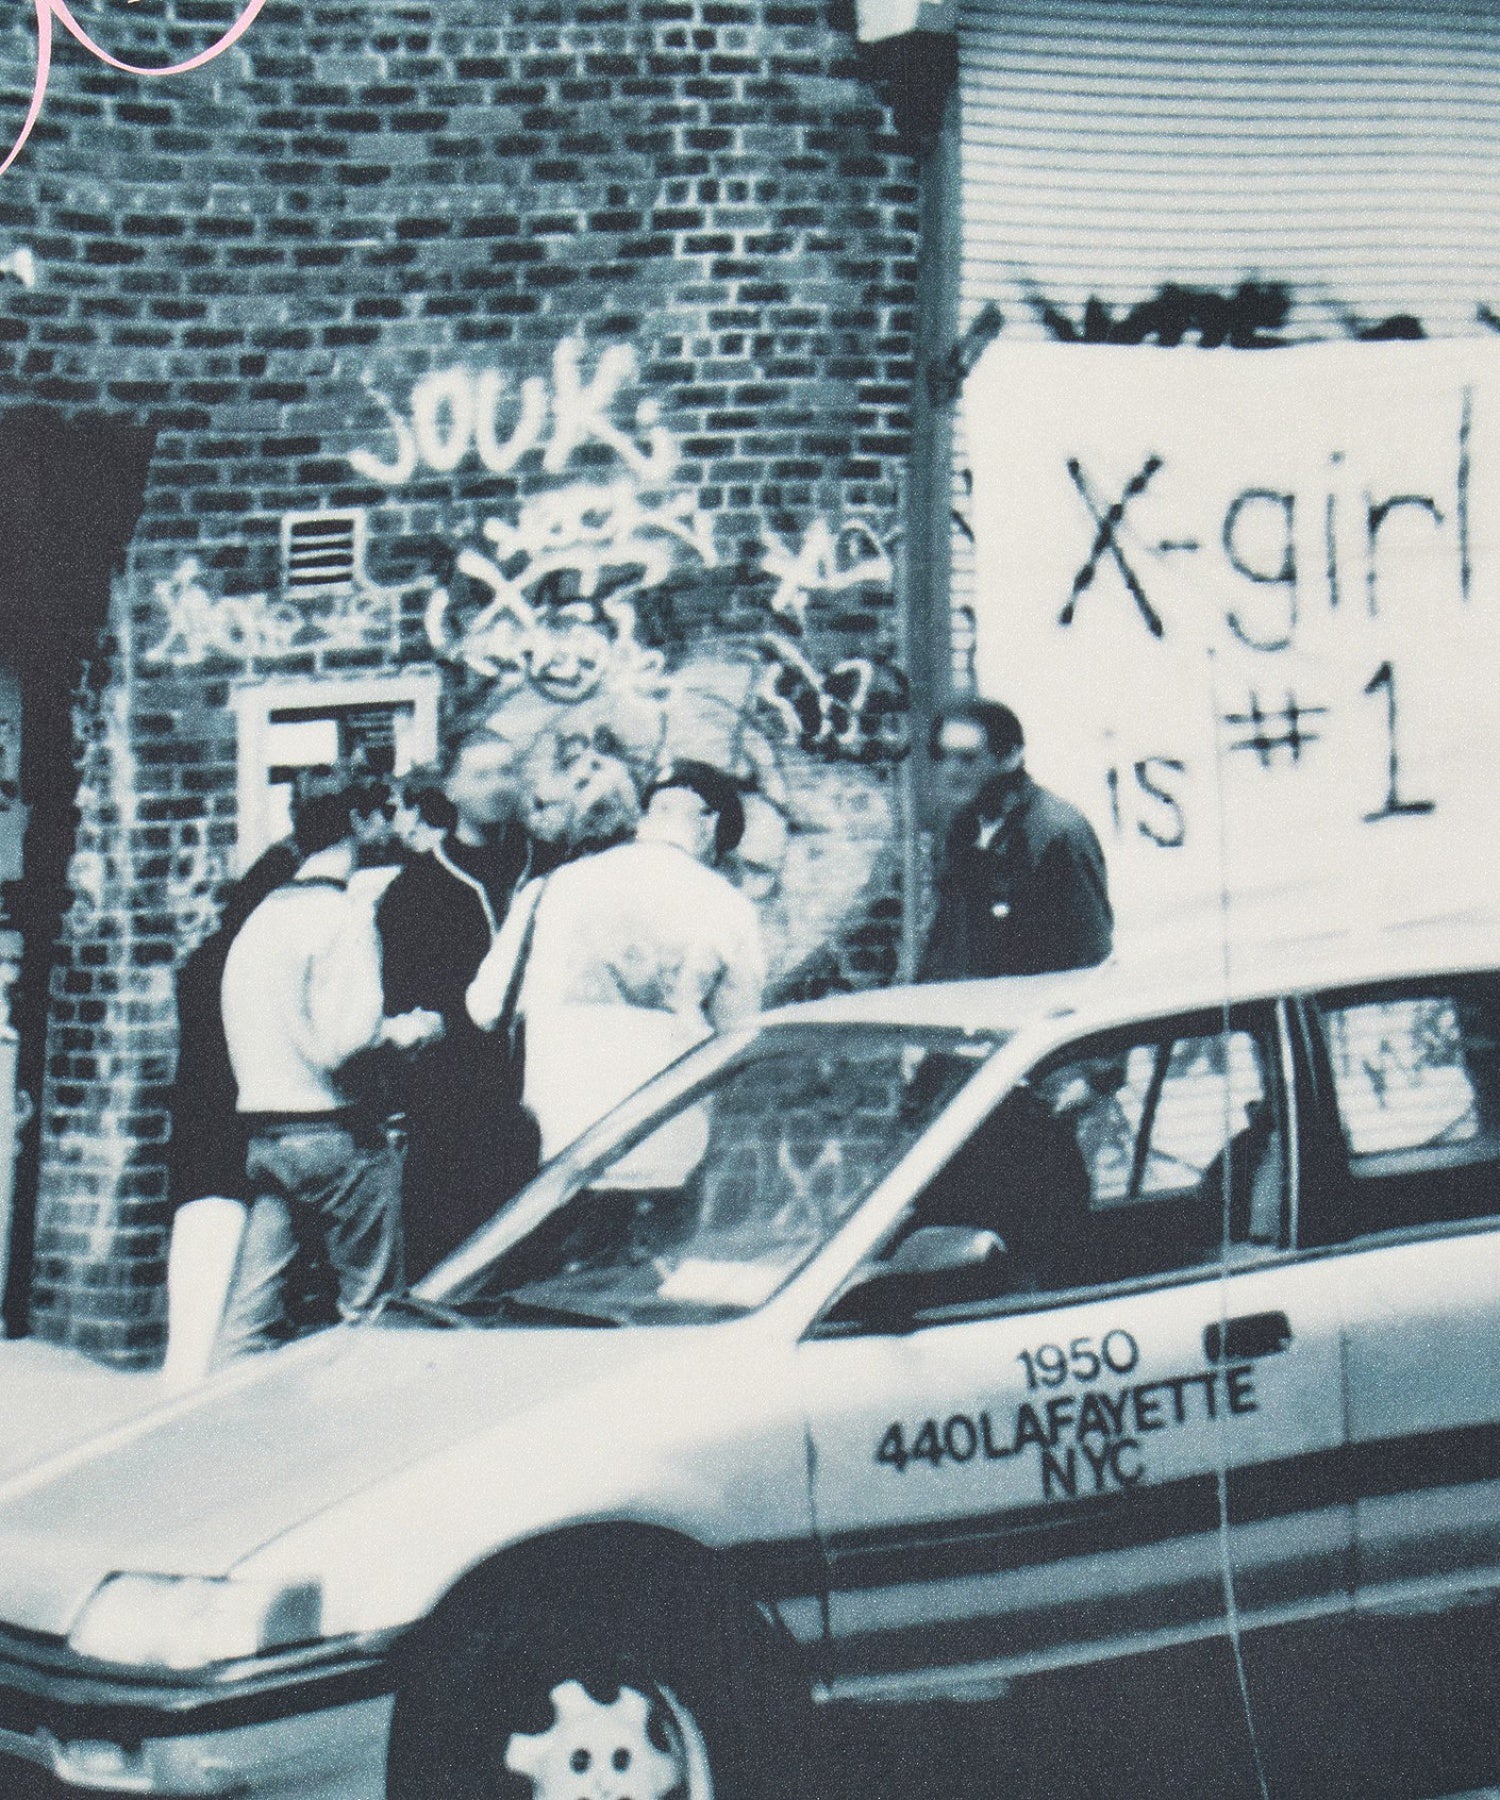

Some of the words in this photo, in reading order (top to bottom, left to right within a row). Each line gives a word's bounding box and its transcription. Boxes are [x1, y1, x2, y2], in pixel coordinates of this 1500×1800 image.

[1057, 384, 1476, 652] X-girl
[1103, 729, 1187, 848] is
[1016, 1329, 1140, 1389] 1950
[1040, 1438, 1146, 1500] NYC
